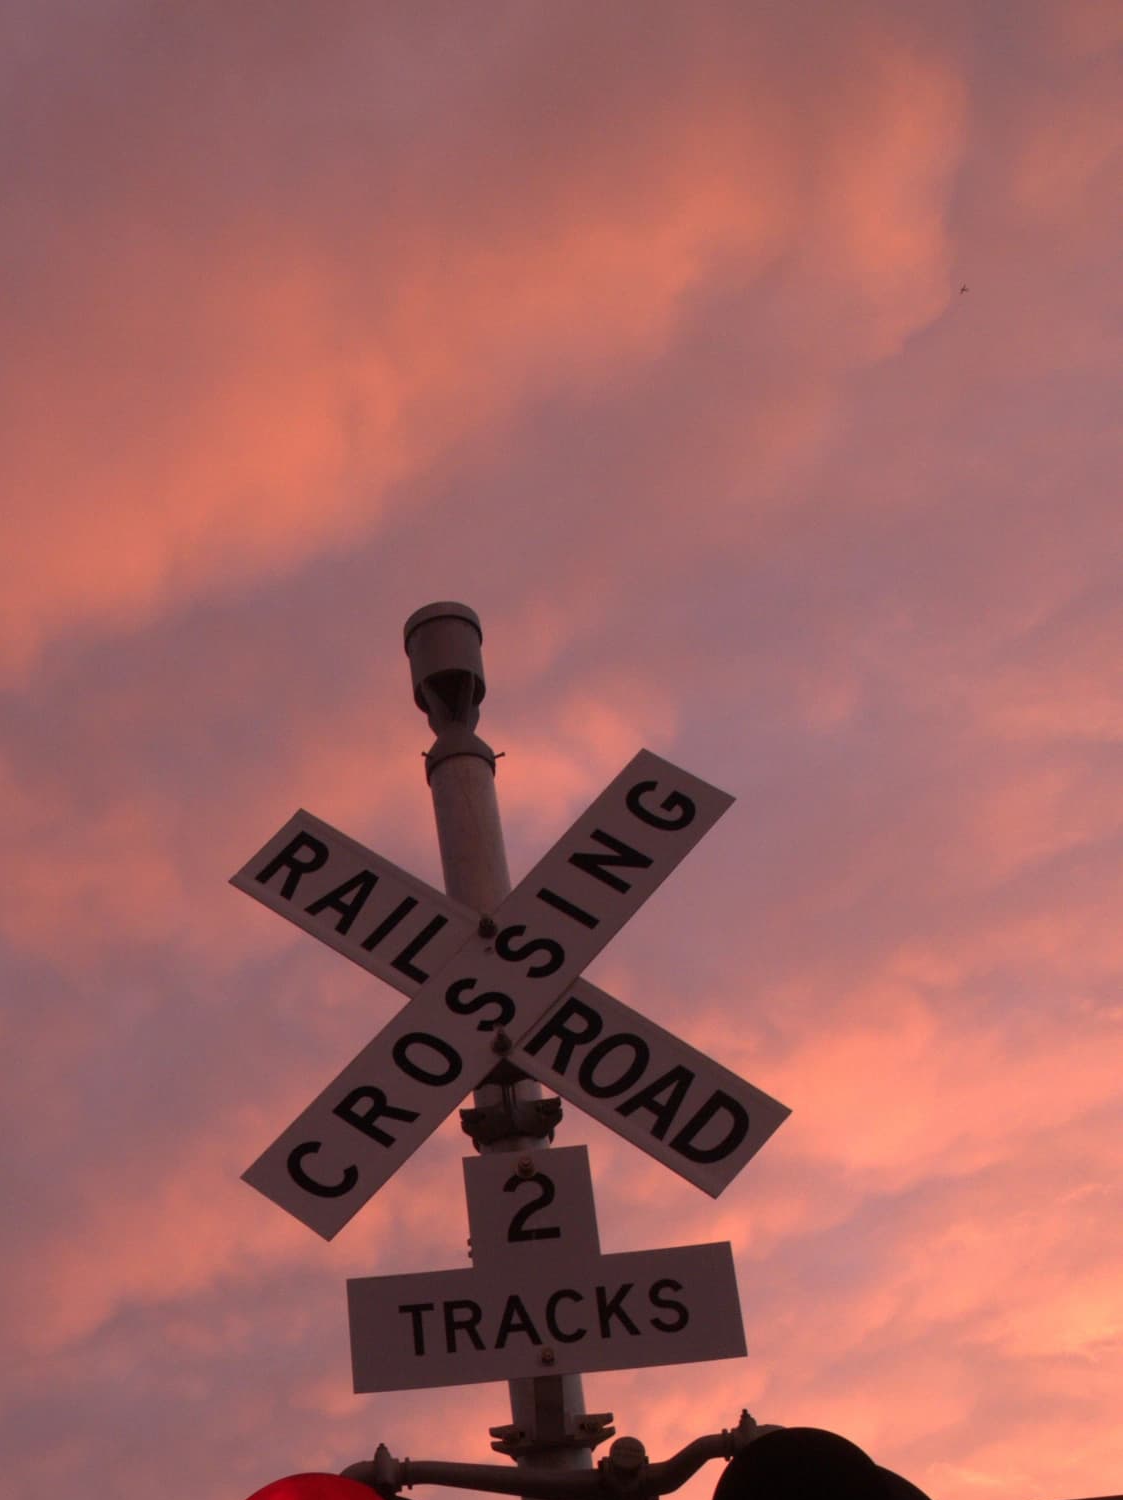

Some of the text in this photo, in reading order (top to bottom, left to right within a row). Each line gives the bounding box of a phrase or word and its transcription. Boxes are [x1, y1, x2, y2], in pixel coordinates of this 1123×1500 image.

[255, 830, 448, 984] RAIL
[287, 780, 697, 1200] CROSSING
[524, 997, 750, 1164] ROAD
[503, 1171, 561, 1243] 2
[399, 1279, 690, 1357] TRACKS
